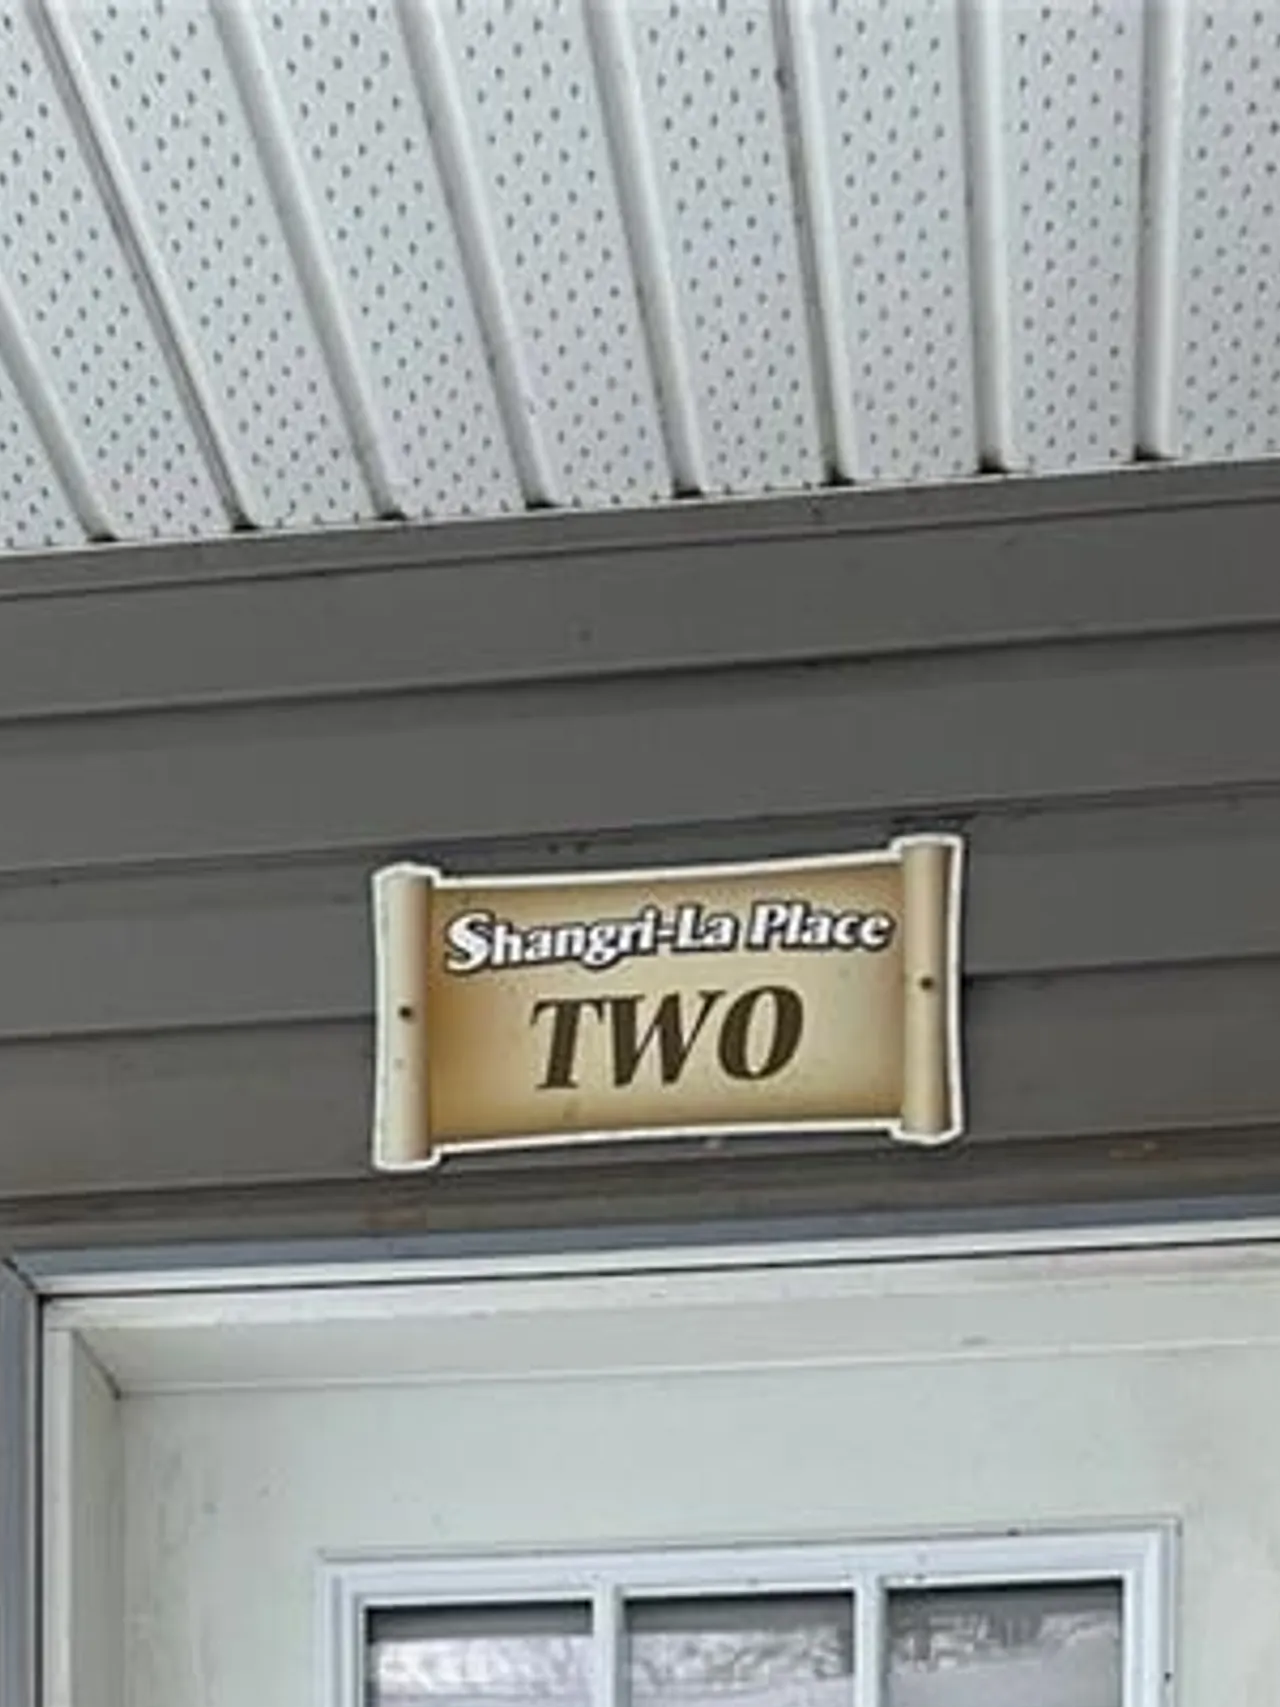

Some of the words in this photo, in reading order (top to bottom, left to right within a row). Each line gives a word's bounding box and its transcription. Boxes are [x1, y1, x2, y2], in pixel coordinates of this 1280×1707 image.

[445, 903, 733, 973] Shangri-La
[746, 900, 896, 956] Place
[531, 986, 804, 1091] TWO
